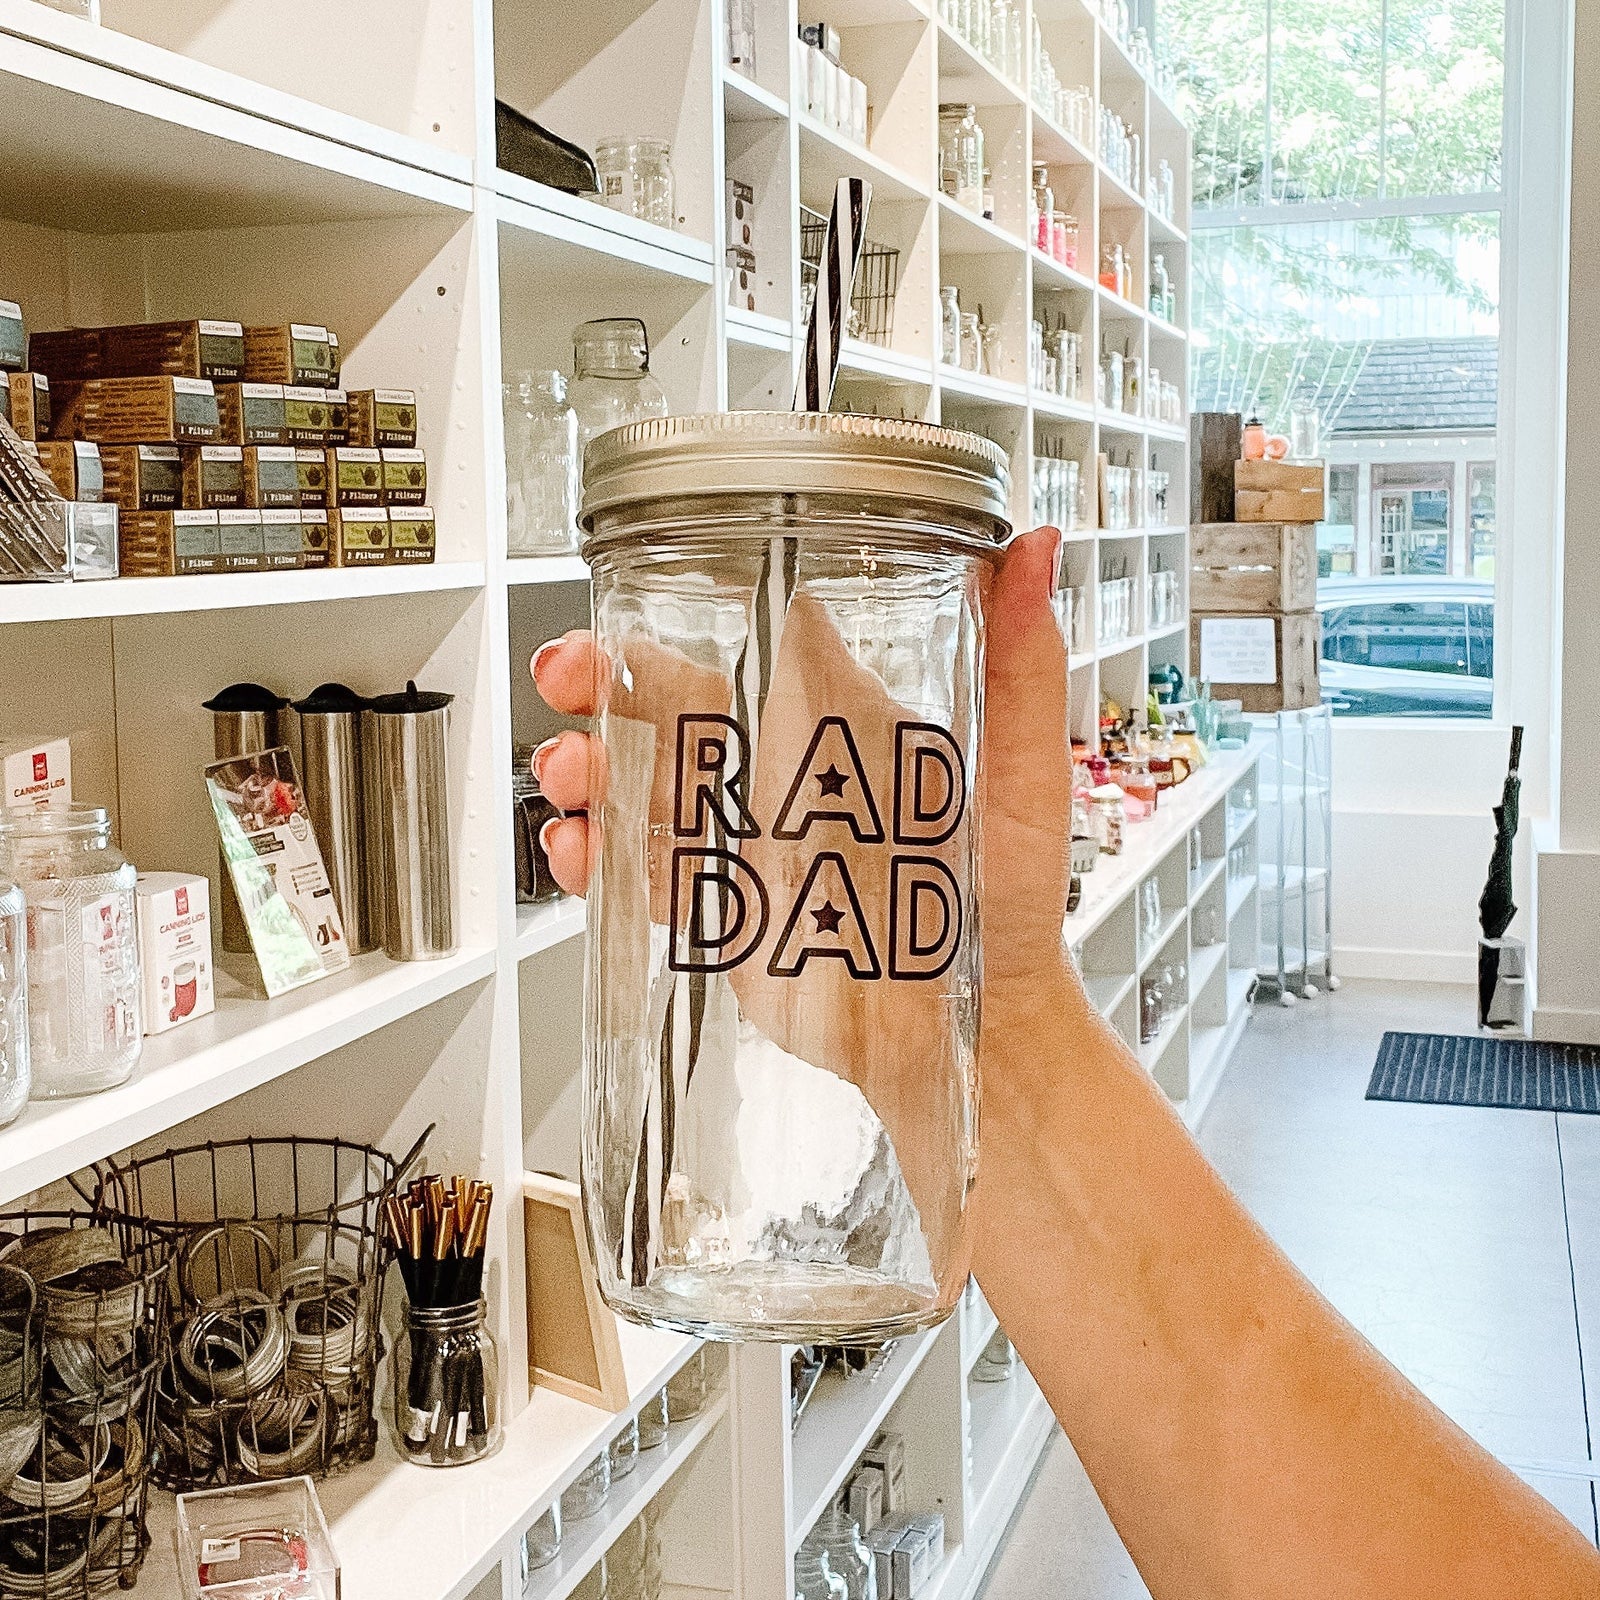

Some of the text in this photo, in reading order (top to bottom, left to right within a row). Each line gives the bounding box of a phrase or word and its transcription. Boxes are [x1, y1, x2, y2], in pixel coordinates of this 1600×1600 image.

[13, 781, 49, 797] CANNING
[50, 777, 66, 788] LIDS
[673, 713, 966, 846] RAD
[159, 911, 206, 934] CANNING LIDS
[668, 847, 963, 981] DAD
